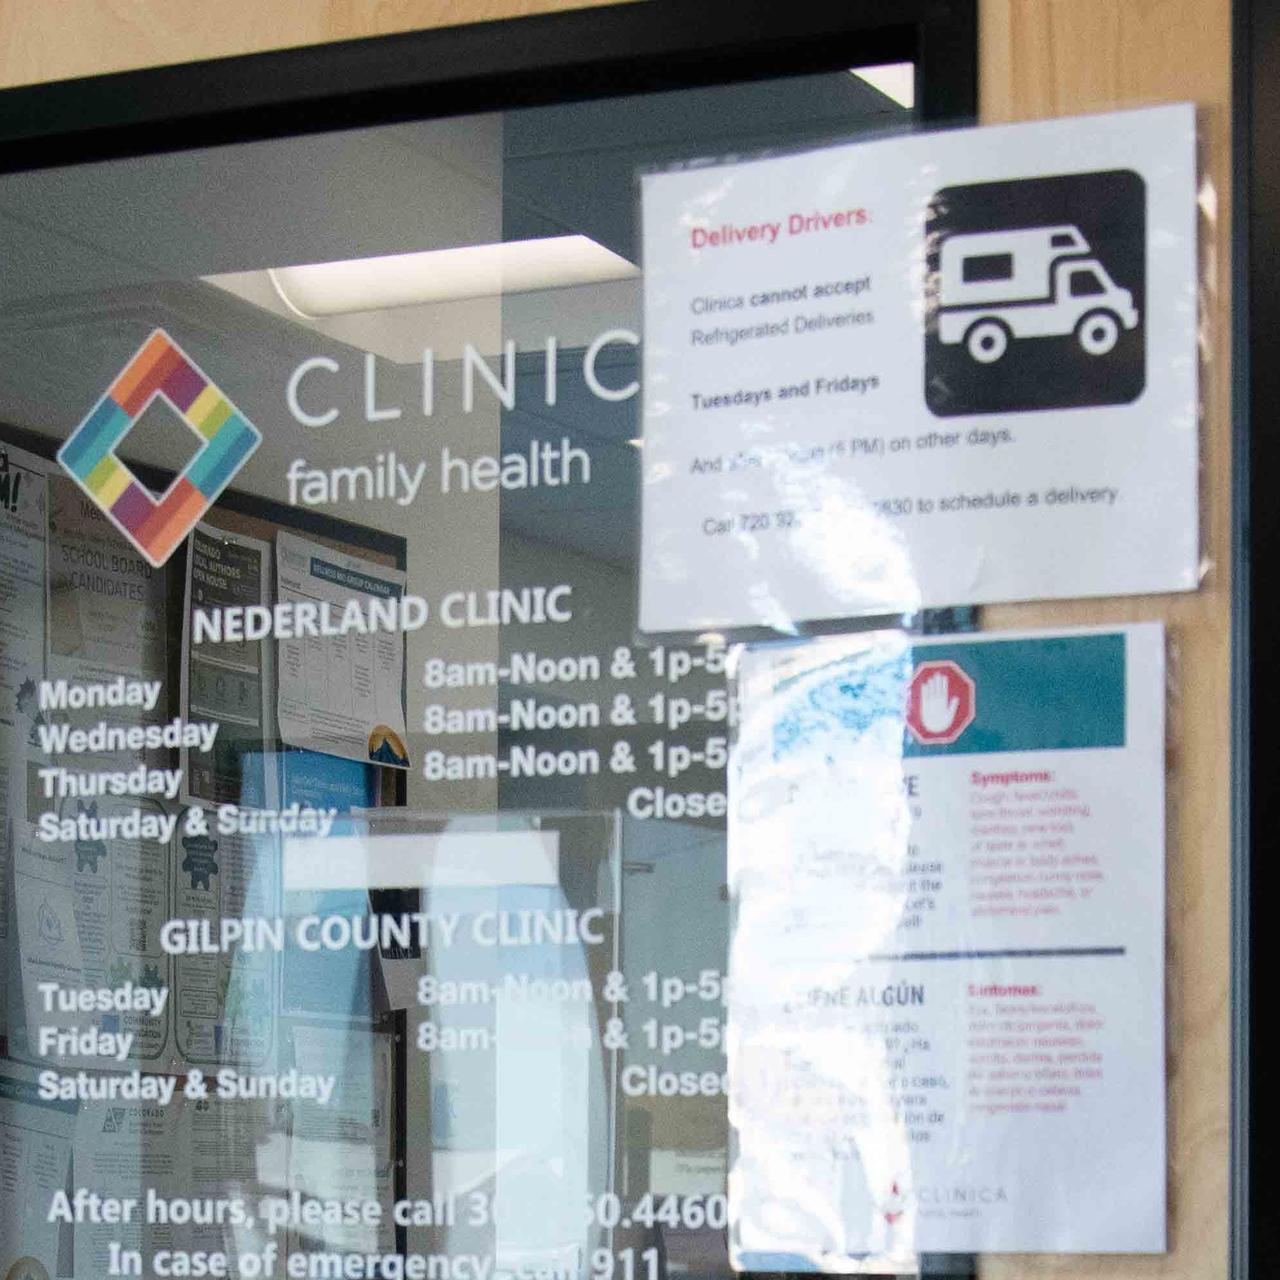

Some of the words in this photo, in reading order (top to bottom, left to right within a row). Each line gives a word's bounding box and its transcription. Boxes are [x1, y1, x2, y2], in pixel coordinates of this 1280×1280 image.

[691, 220, 781, 249] Delivery
[750, 285, 808, 308] cannot
[813, 276, 871, 299] accept
[691, 320, 790, 347] Refrigerated
[794, 310, 874, 335] Deliveries
[691, 386, 772, 410] Tuesdays
[778, 381, 810, 400] and
[815, 372, 880, 397] Fridays
[889, 437, 911, 452] on
[914, 431, 961, 451] other
[286, 453, 426, 508] family
[441, 438, 591, 495] health
[915, 497, 934, 514] to
[939, 490, 1020, 512] schedule
[1026, 493, 1040, 507] a
[192, 595, 428, 644] NEDERLAND
[439, 585, 573, 629] CLINIC
[38, 675, 162, 710] Monday
[423, 652, 600, 688] 8am-Noon
[610, 646, 636, 679] &
[648, 642, 729, 682] 1p-5
[38, 717, 219, 754] Wednesday
[423, 698, 600, 735] 8am-Noon
[609, 693, 637, 727] &
[38, 764, 183, 800] Thursday
[423, 746, 600, 780] 8am-Noon
[609, 740, 636, 773] &
[648, 737, 728, 778] 1p-5
[38, 812, 177, 844] Saturday
[184, 807, 209, 837] &
[217, 803, 338, 838] Sunday
[626, 787, 728, 819] Close
[159, 917, 285, 955] GILPIN
[296, 911, 458, 951] COUNTY
[473, 907, 605, 947] CLINIC
[38, 981, 170, 1017] Tuesday
[417, 972, 592, 1006] 8am-Noon
[603, 970, 630, 1004] &
[642, 970, 728, 1007] 1p-5
[38, 1026, 135, 1061] Friday
[603, 1017, 629, 1050] &
[642, 1018, 728, 1055] 1p-5
[38, 1070, 177, 1106] Saturday
[183, 1068, 209, 1101] &
[216, 1068, 337, 1105] Sunday
[47, 1188, 137, 1225] After
[147, 1188, 255, 1229] hours,
[270, 1190, 383, 1233] please
[393, 1190, 455, 1227] call
[108, 1244, 143, 1278] In
[153, 1250, 227, 1279] case
[237, 1242, 278, 1279] of
